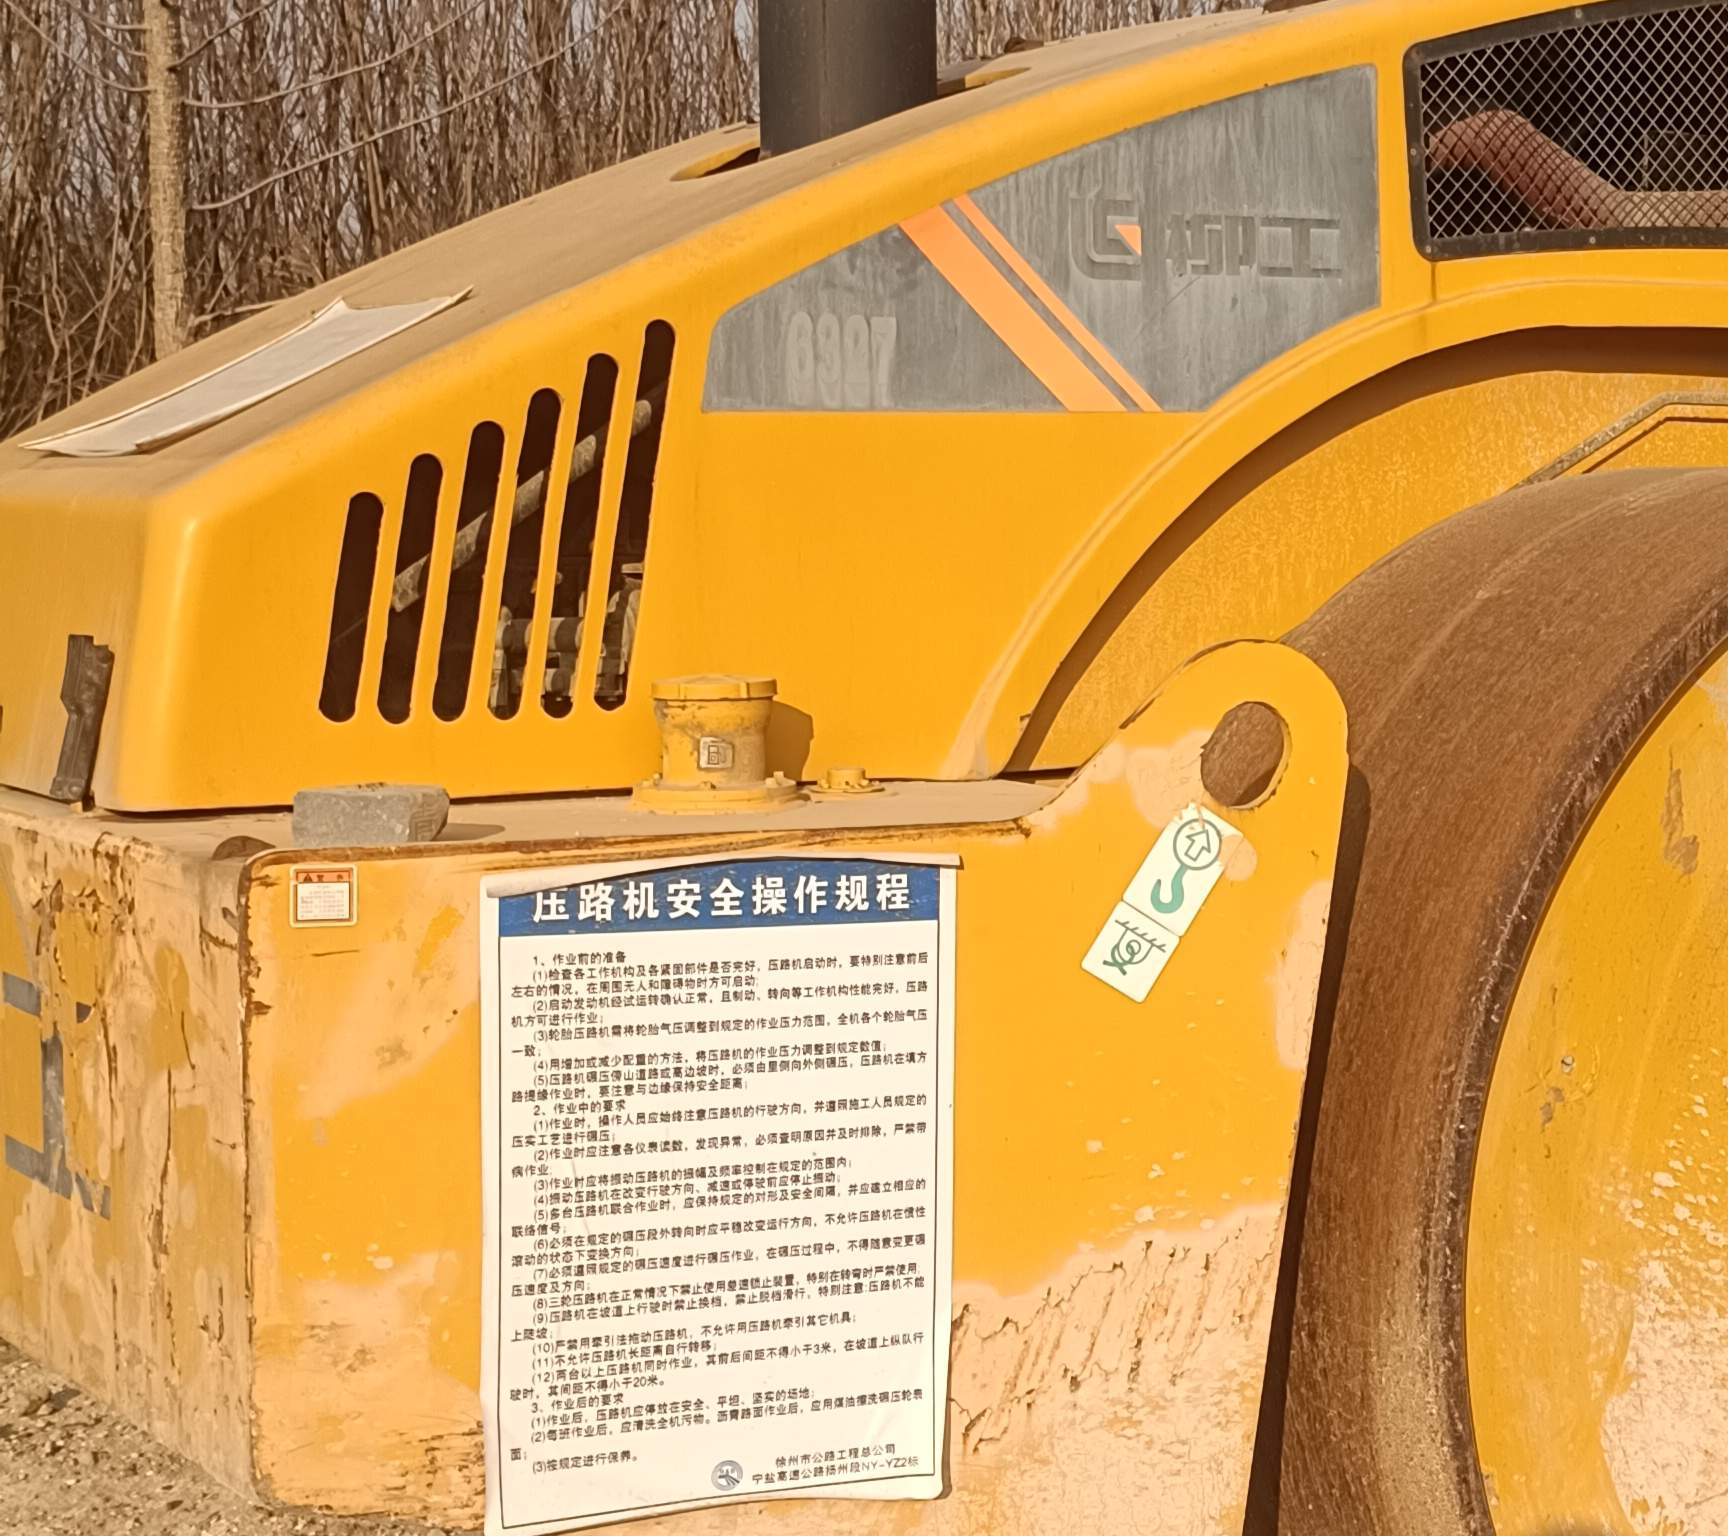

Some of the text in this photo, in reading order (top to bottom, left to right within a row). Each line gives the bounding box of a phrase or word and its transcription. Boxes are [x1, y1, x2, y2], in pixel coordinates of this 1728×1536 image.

[532, 872, 911, 924] 压路机安全操作规程
